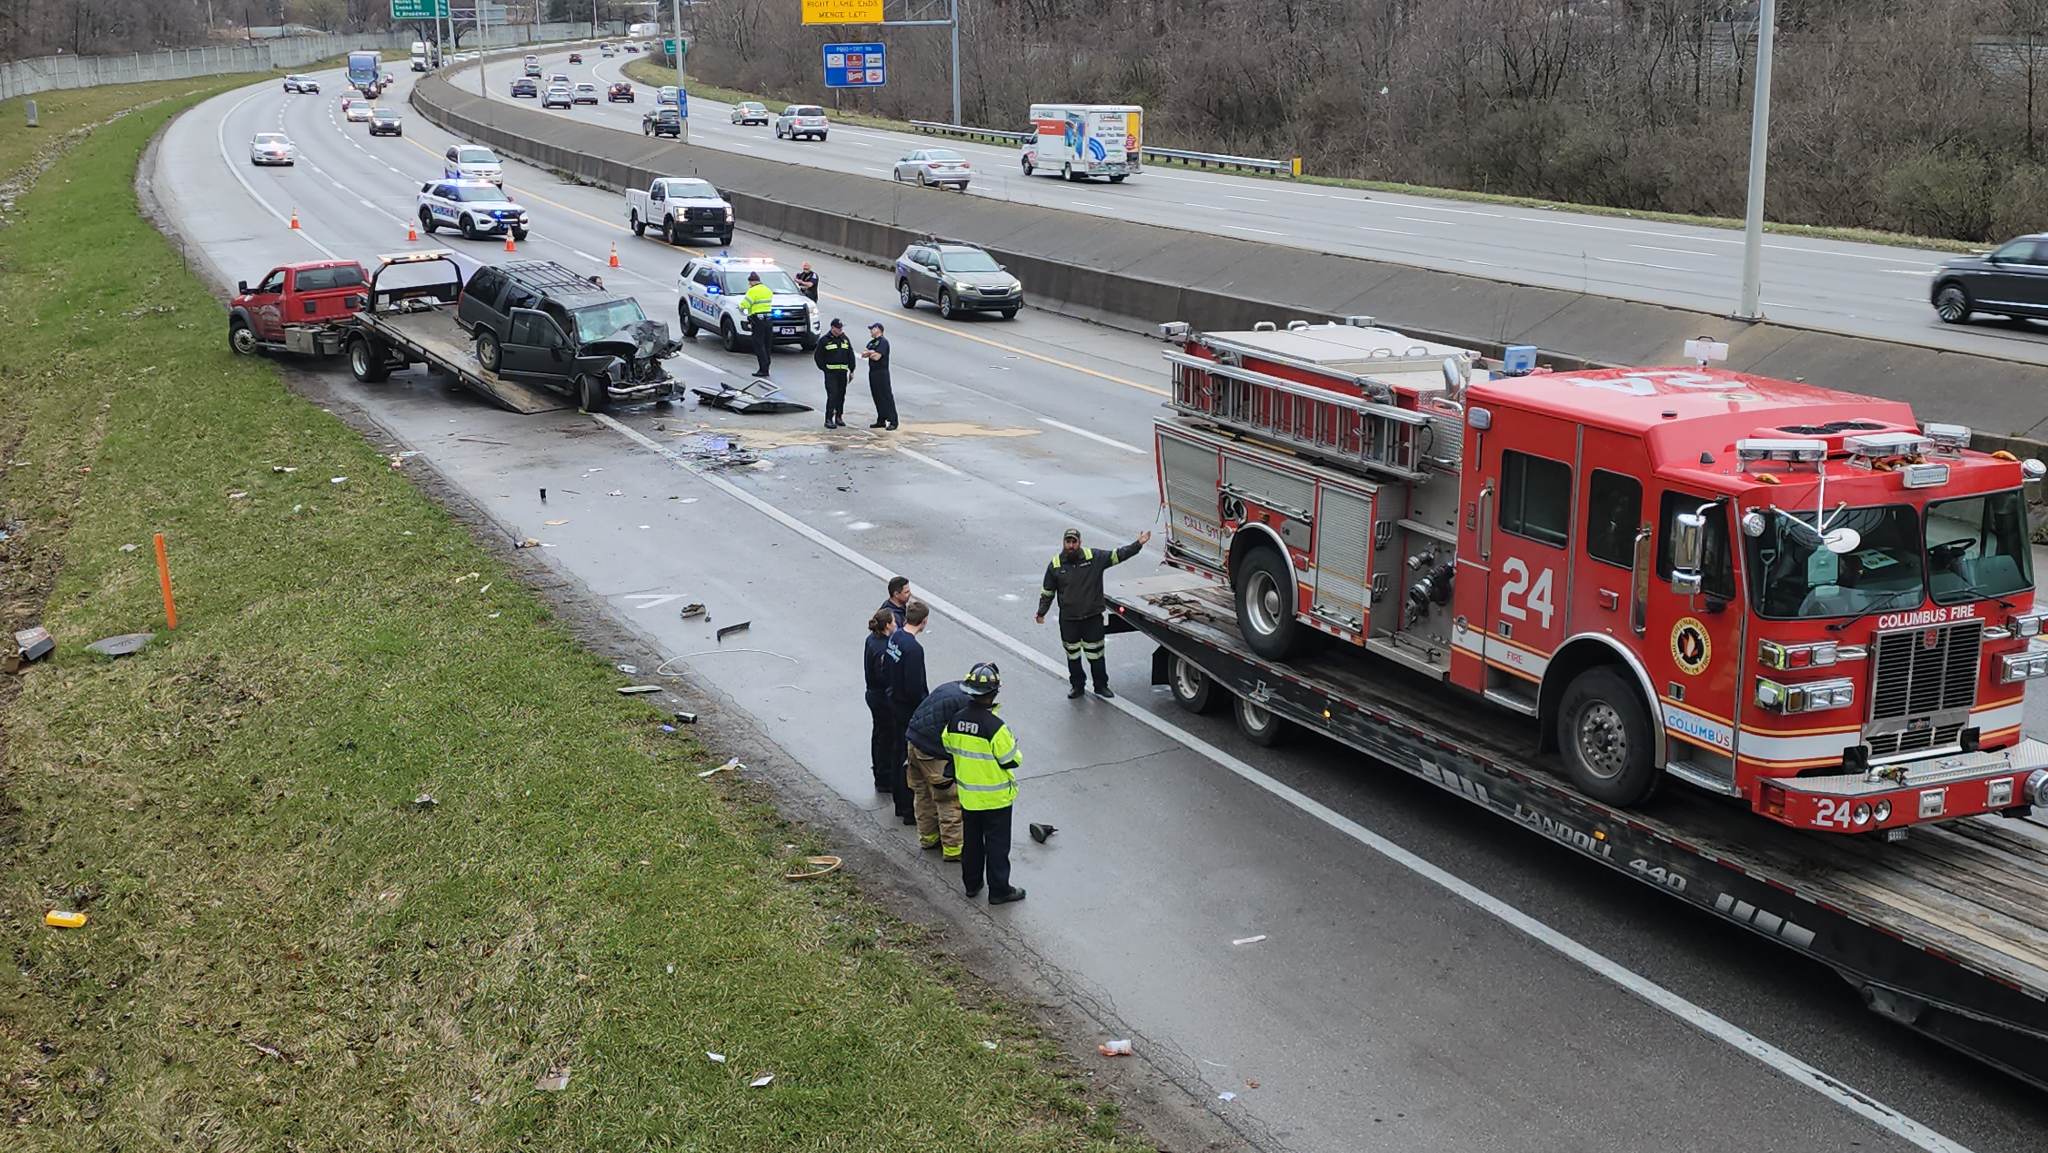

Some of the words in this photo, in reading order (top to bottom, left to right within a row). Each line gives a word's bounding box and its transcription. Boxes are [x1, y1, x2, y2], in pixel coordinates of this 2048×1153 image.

[691, 296, 715, 317] POLICE
[1500, 556, 1554, 630] 24
[1878, 607, 1947, 629] COLUMBUS
[1950, 603, 1976, 620] FIRE
[1506, 650, 1523, 665] FIRE
[957, 720, 979, 735] CFD
[1668, 715, 1730, 747] COLUMBUS
[1816, 798, 1852, 829] 24
[1513, 803, 1616, 862] LANDOLL
[1628, 858, 1687, 892] 440
